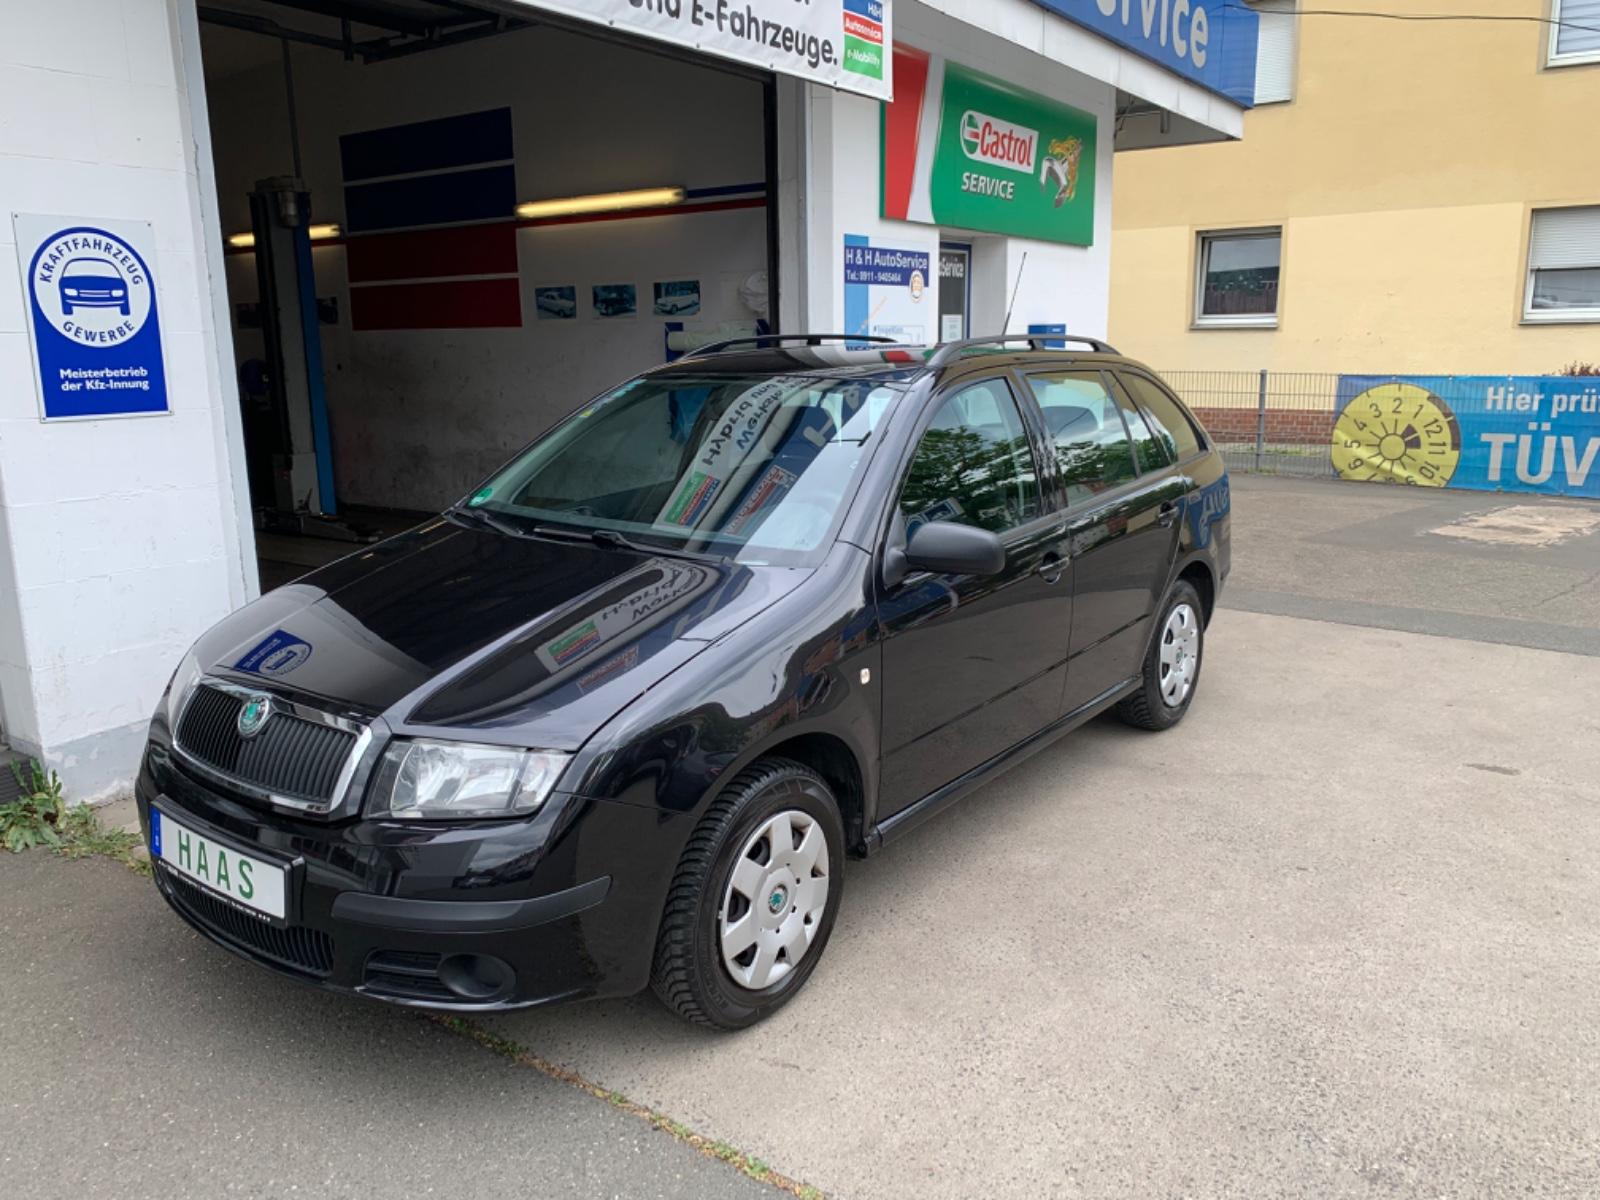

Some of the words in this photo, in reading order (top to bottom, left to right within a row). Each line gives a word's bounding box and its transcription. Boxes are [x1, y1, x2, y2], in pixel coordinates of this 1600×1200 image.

[690, 0, 839, 68] E-Fahrzeuge.
[1096, 0, 1210, 69] vice
[979, 120, 1034, 167] Castrol
[961, 171, 1016, 201] SERVICE
[39, 236, 144, 286] KRAFTFAHRZEUG
[845, 248, 854, 265] H
[855, 249, 863, 265] &
[864, 249, 872, 266] H
[874, 250, 929, 269] AutoService
[62, 320, 135, 343] GEWERBE
[59, 367, 148, 380] Meisterbetrieb
[61, 380, 82, 391] der
[85, 379, 150, 391] Kfz-Innung
[1370, 402, 1382, 419] 3
[1391, 397, 1402, 414] 2
[1413, 404, 1424, 419] 1
[1485, 386, 1544, 411] Hier
[1550, 388, 1600, 418] prü
[1424, 418, 1443, 438] 12
[1428, 441, 1447, 456] 11
[1480, 422, 1600, 487] TÜV
[1419, 461, 1441, 479] 10
[177, 829, 254, 900] HAAS
